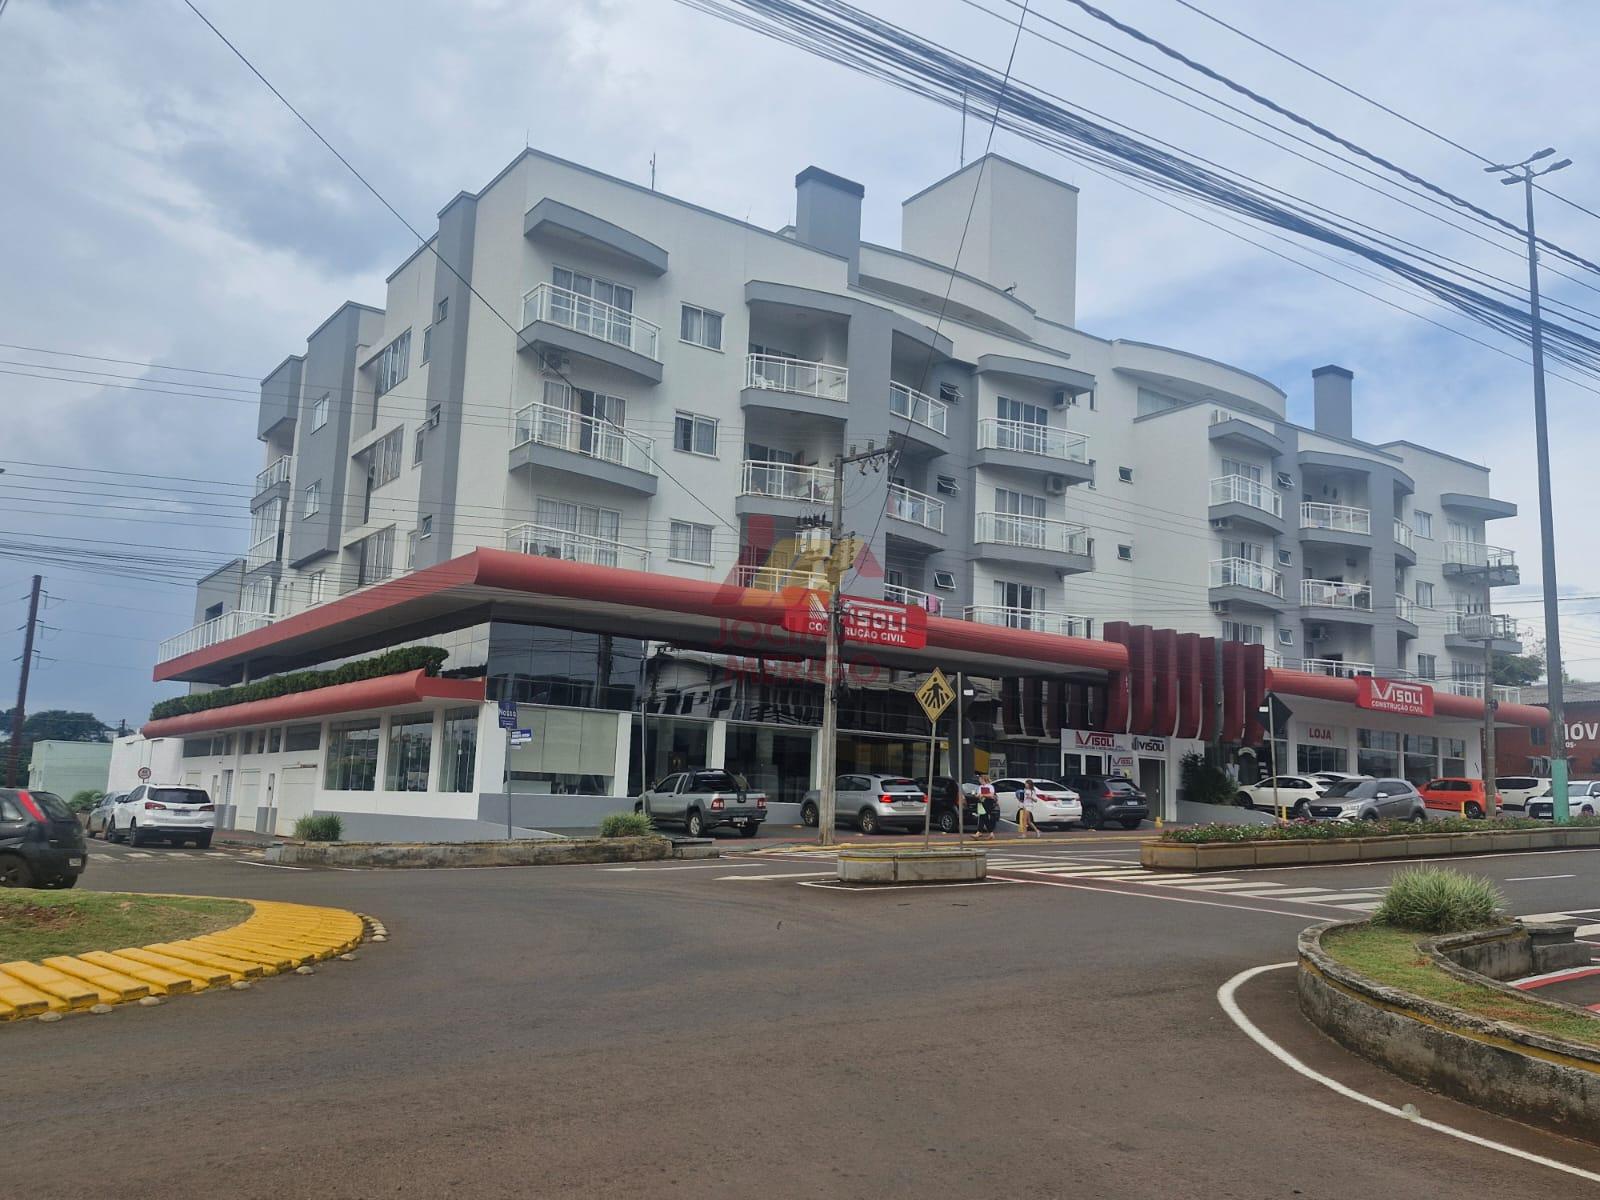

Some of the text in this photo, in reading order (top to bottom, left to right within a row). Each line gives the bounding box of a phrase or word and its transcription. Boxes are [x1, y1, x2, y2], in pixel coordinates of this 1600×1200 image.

[880, 632, 906, 643] CIVIL
[1371, 680, 1423, 705] VISOLI
[1371, 700, 1424, 713] CONSTRUÇÃO CIVIL
[1076, 731, 1115, 747] VISOLI
[1309, 727, 1332, 740] LOJA
